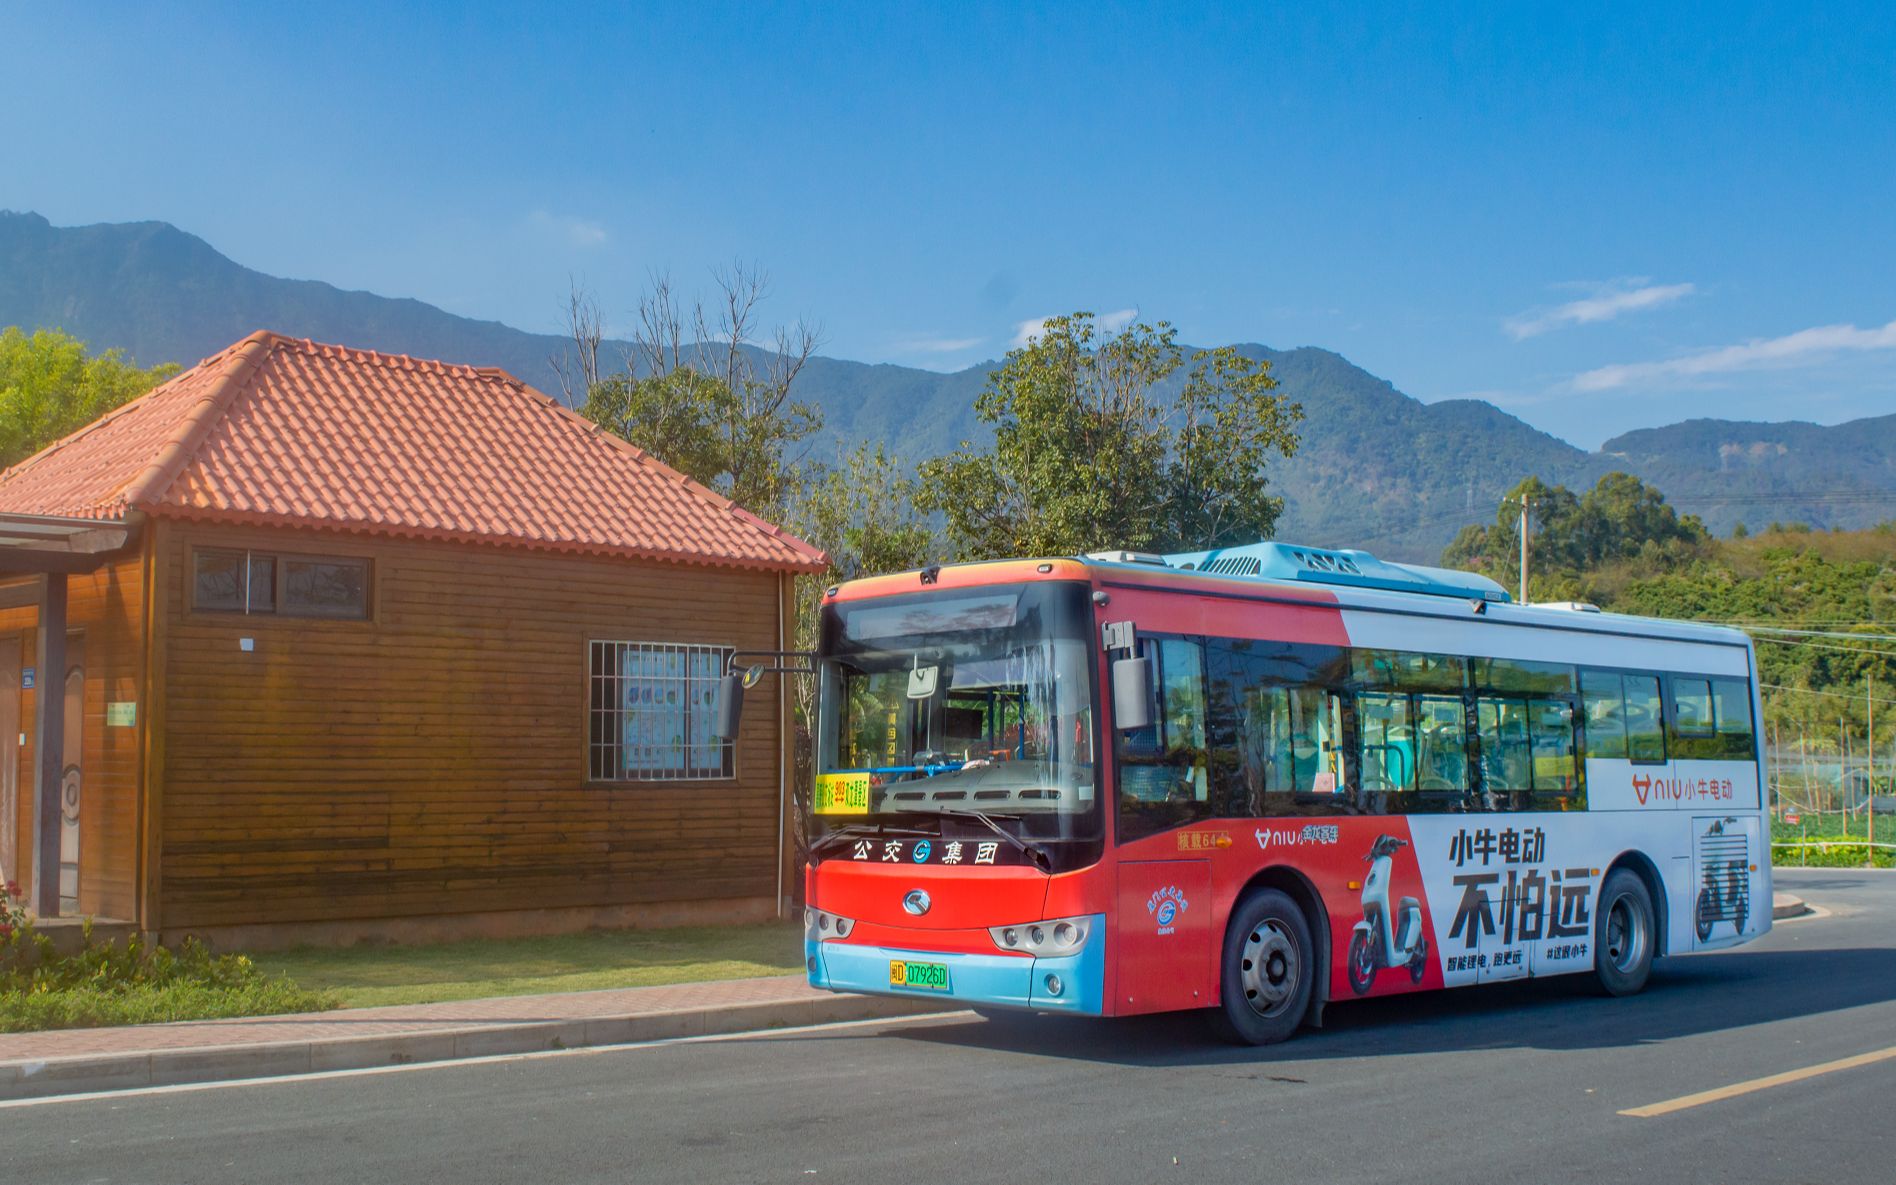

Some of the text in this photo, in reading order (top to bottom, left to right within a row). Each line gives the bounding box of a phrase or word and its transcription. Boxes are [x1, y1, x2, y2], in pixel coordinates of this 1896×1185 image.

[1684, 778, 1733, 801] 小牛电动
[1179, 832, 1220, 849] 核载64
[1448, 826, 1546, 867] 小牛电动
[1447, 868, 1591, 949] 不怕远
